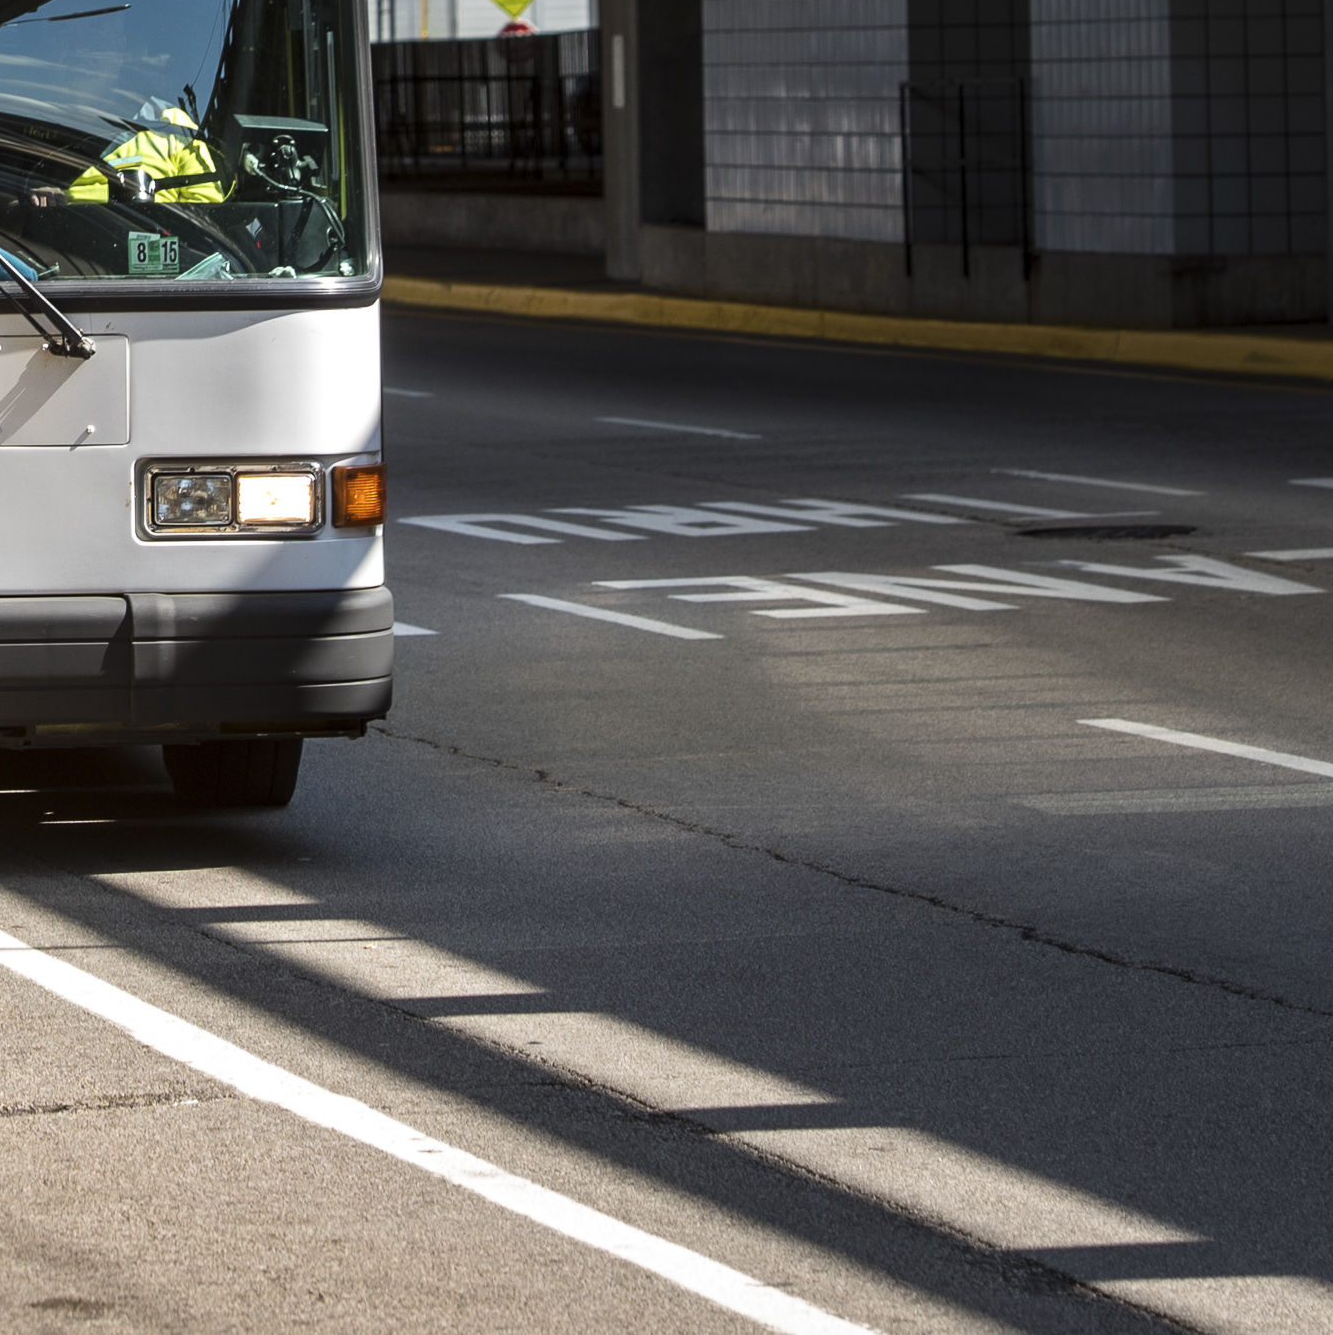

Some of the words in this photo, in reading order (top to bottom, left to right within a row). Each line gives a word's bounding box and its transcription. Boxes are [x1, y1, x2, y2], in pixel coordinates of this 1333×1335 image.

[137, 242, 147, 263] 8
[161, 240, 177, 263] 15
[396, 493, 1162, 546] THRU
